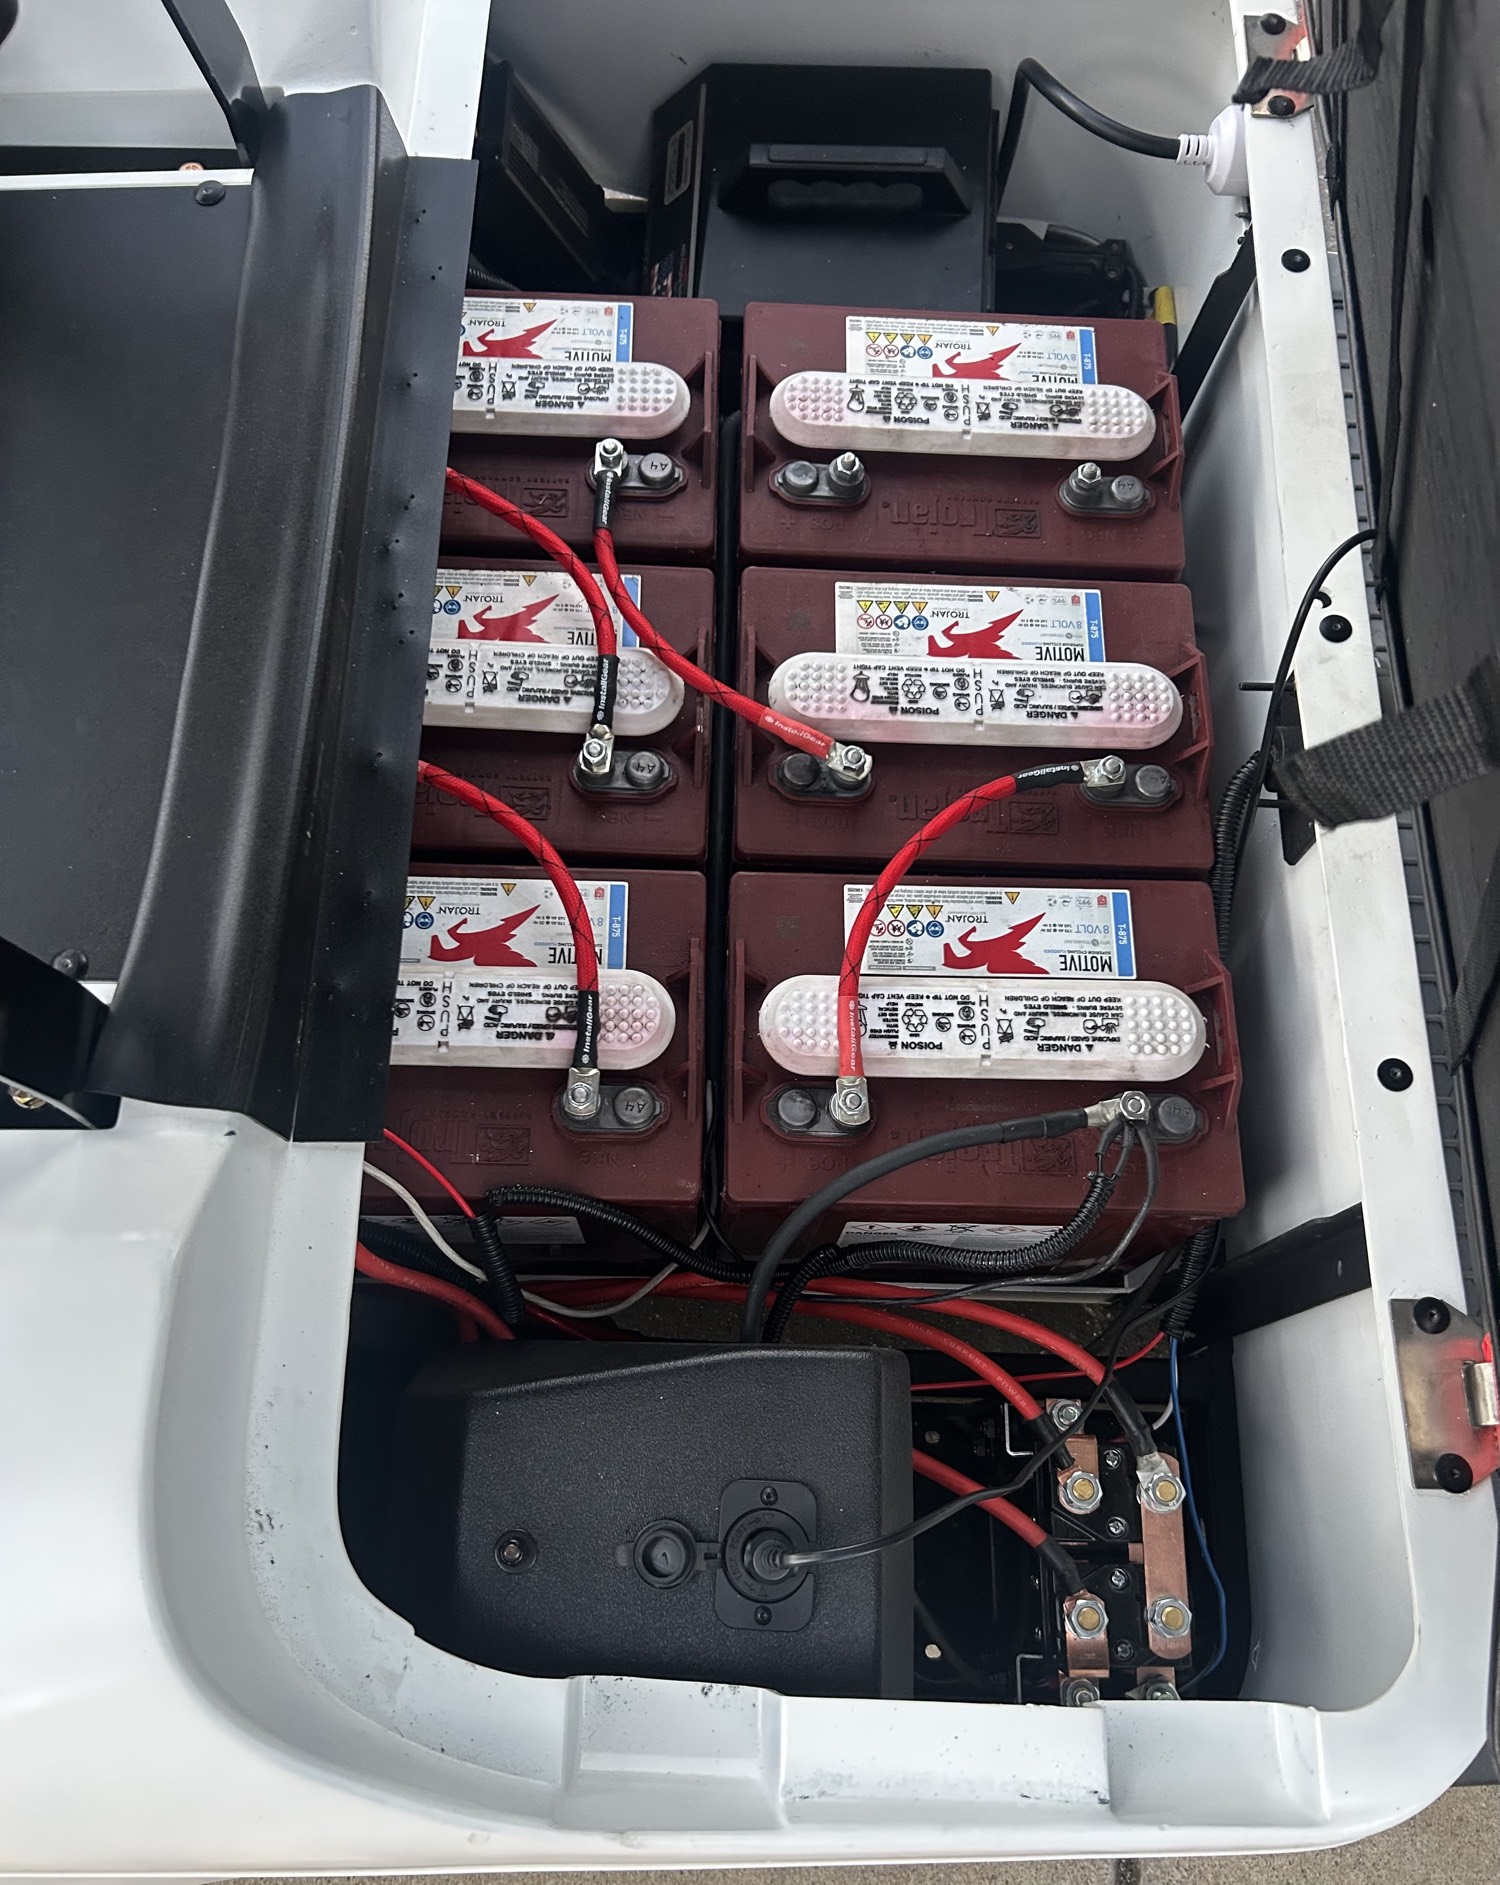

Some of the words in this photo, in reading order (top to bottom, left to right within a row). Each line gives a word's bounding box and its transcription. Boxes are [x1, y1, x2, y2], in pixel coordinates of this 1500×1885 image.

[488, 363, 497, 404] PUSH
[535, 400, 574, 408] DANGER
[961, 384, 970, 425] PUSH
[894, 416, 929, 424] POISON
[1011, 422, 1048, 430] DANGER
[651, 462, 668, 471] A4
[602, 478, 611, 524] InstallGear
[466, 595, 504, 603] TROJAN
[1051, 620, 1074, 628] VOLT
[1090, 619, 1098, 638] T-875
[1035, 646, 1084, 662] MOTIVE
[467, 650, 478, 698] PUSH
[599, 658, 608, 709] InstallGear
[973, 669, 983, 715] PUSH
[518, 695, 560, 703] DANGER
[901, 707, 939, 715] POISON
[637, 763, 656, 772] A4
[1018, 765, 1069, 779] InstallGear
[439, 906, 480, 915] TROJAN
[598, 918, 603, 926] 8
[947, 915, 988, 923] TROJAN
[612, 916, 620, 937] T-875
[1075, 925, 1101, 933] VOLT
[1103, 925, 1109, 934] 8
[1118, 924, 1127, 944] T-875
[1059, 955, 1112, 972] MOTIVE
[440, 981, 452, 1036] PUSH
[583, 994, 592, 1052] InstallGear
[979, 995, 990, 1049] PUSH
[496, 1031, 544, 1040] DANGER
[849, 1012, 857, 1071] InstallGear
[901, 1042, 942, 1050] POISON
[1037, 1044, 1081, 1052] DANGER
[625, 1101, 646, 1111] A4
[908, 1322, 933, 1336] HIGH
[943, 1338, 987, 1369] CURRENT
[996, 1375, 1028, 1408] POWER
